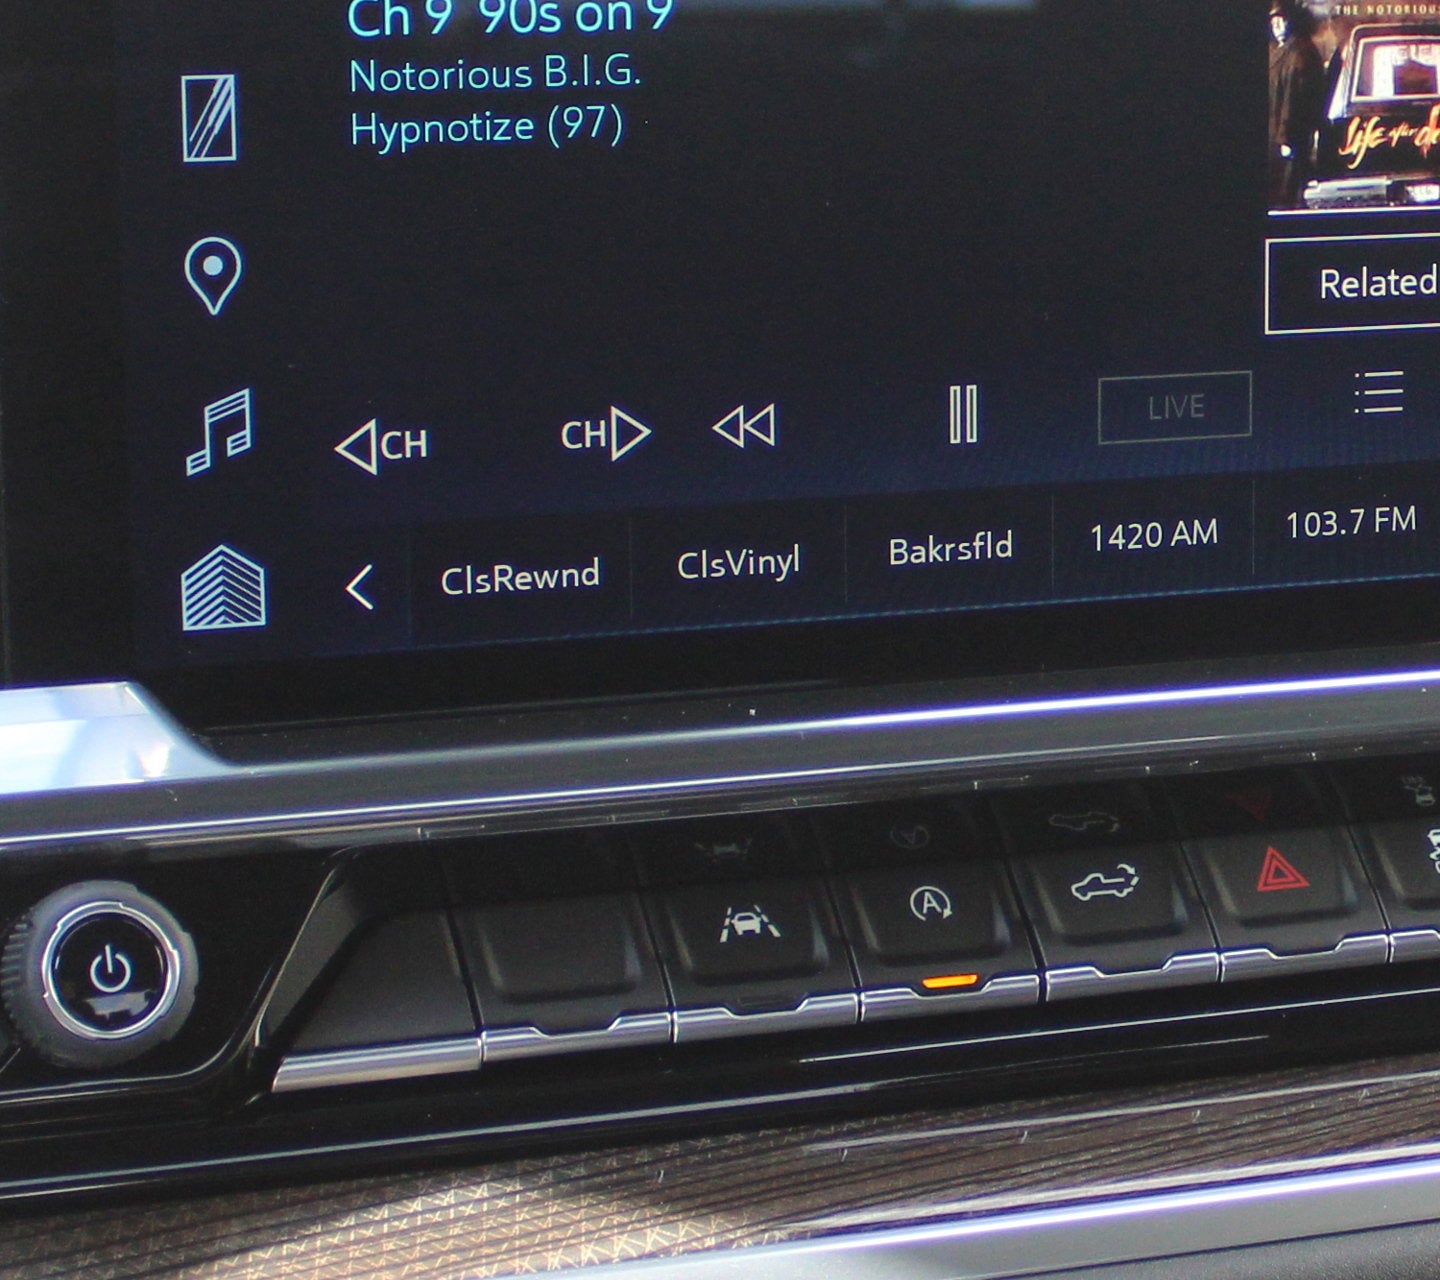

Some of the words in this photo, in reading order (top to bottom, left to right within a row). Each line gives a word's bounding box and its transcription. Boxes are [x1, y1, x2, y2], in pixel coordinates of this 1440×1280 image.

[575, 1, 632, 32] on
[350, 59, 533, 93] Notorious
[545, 52, 641, 87] B.I.G.
[352, 110, 535, 155] Hypnotize
[548, 103, 622, 149] (97)
[1321, 263, 1437, 299] Related
[1149, 393, 1205, 421] LIVE
[381, 429, 427, 460] CH
[561, 419, 606, 449] CH
[1091, 521, 1163, 552] 1420
[1170, 518, 1218, 547] AM
[1287, 508, 1365, 539] 103.7
[1375, 505, 1416, 533] FM
[678, 543, 799, 582] ClsVinyl
[890, 529, 1012, 566] Bakrsfld
[441, 556, 600, 595] ClsRewnd
